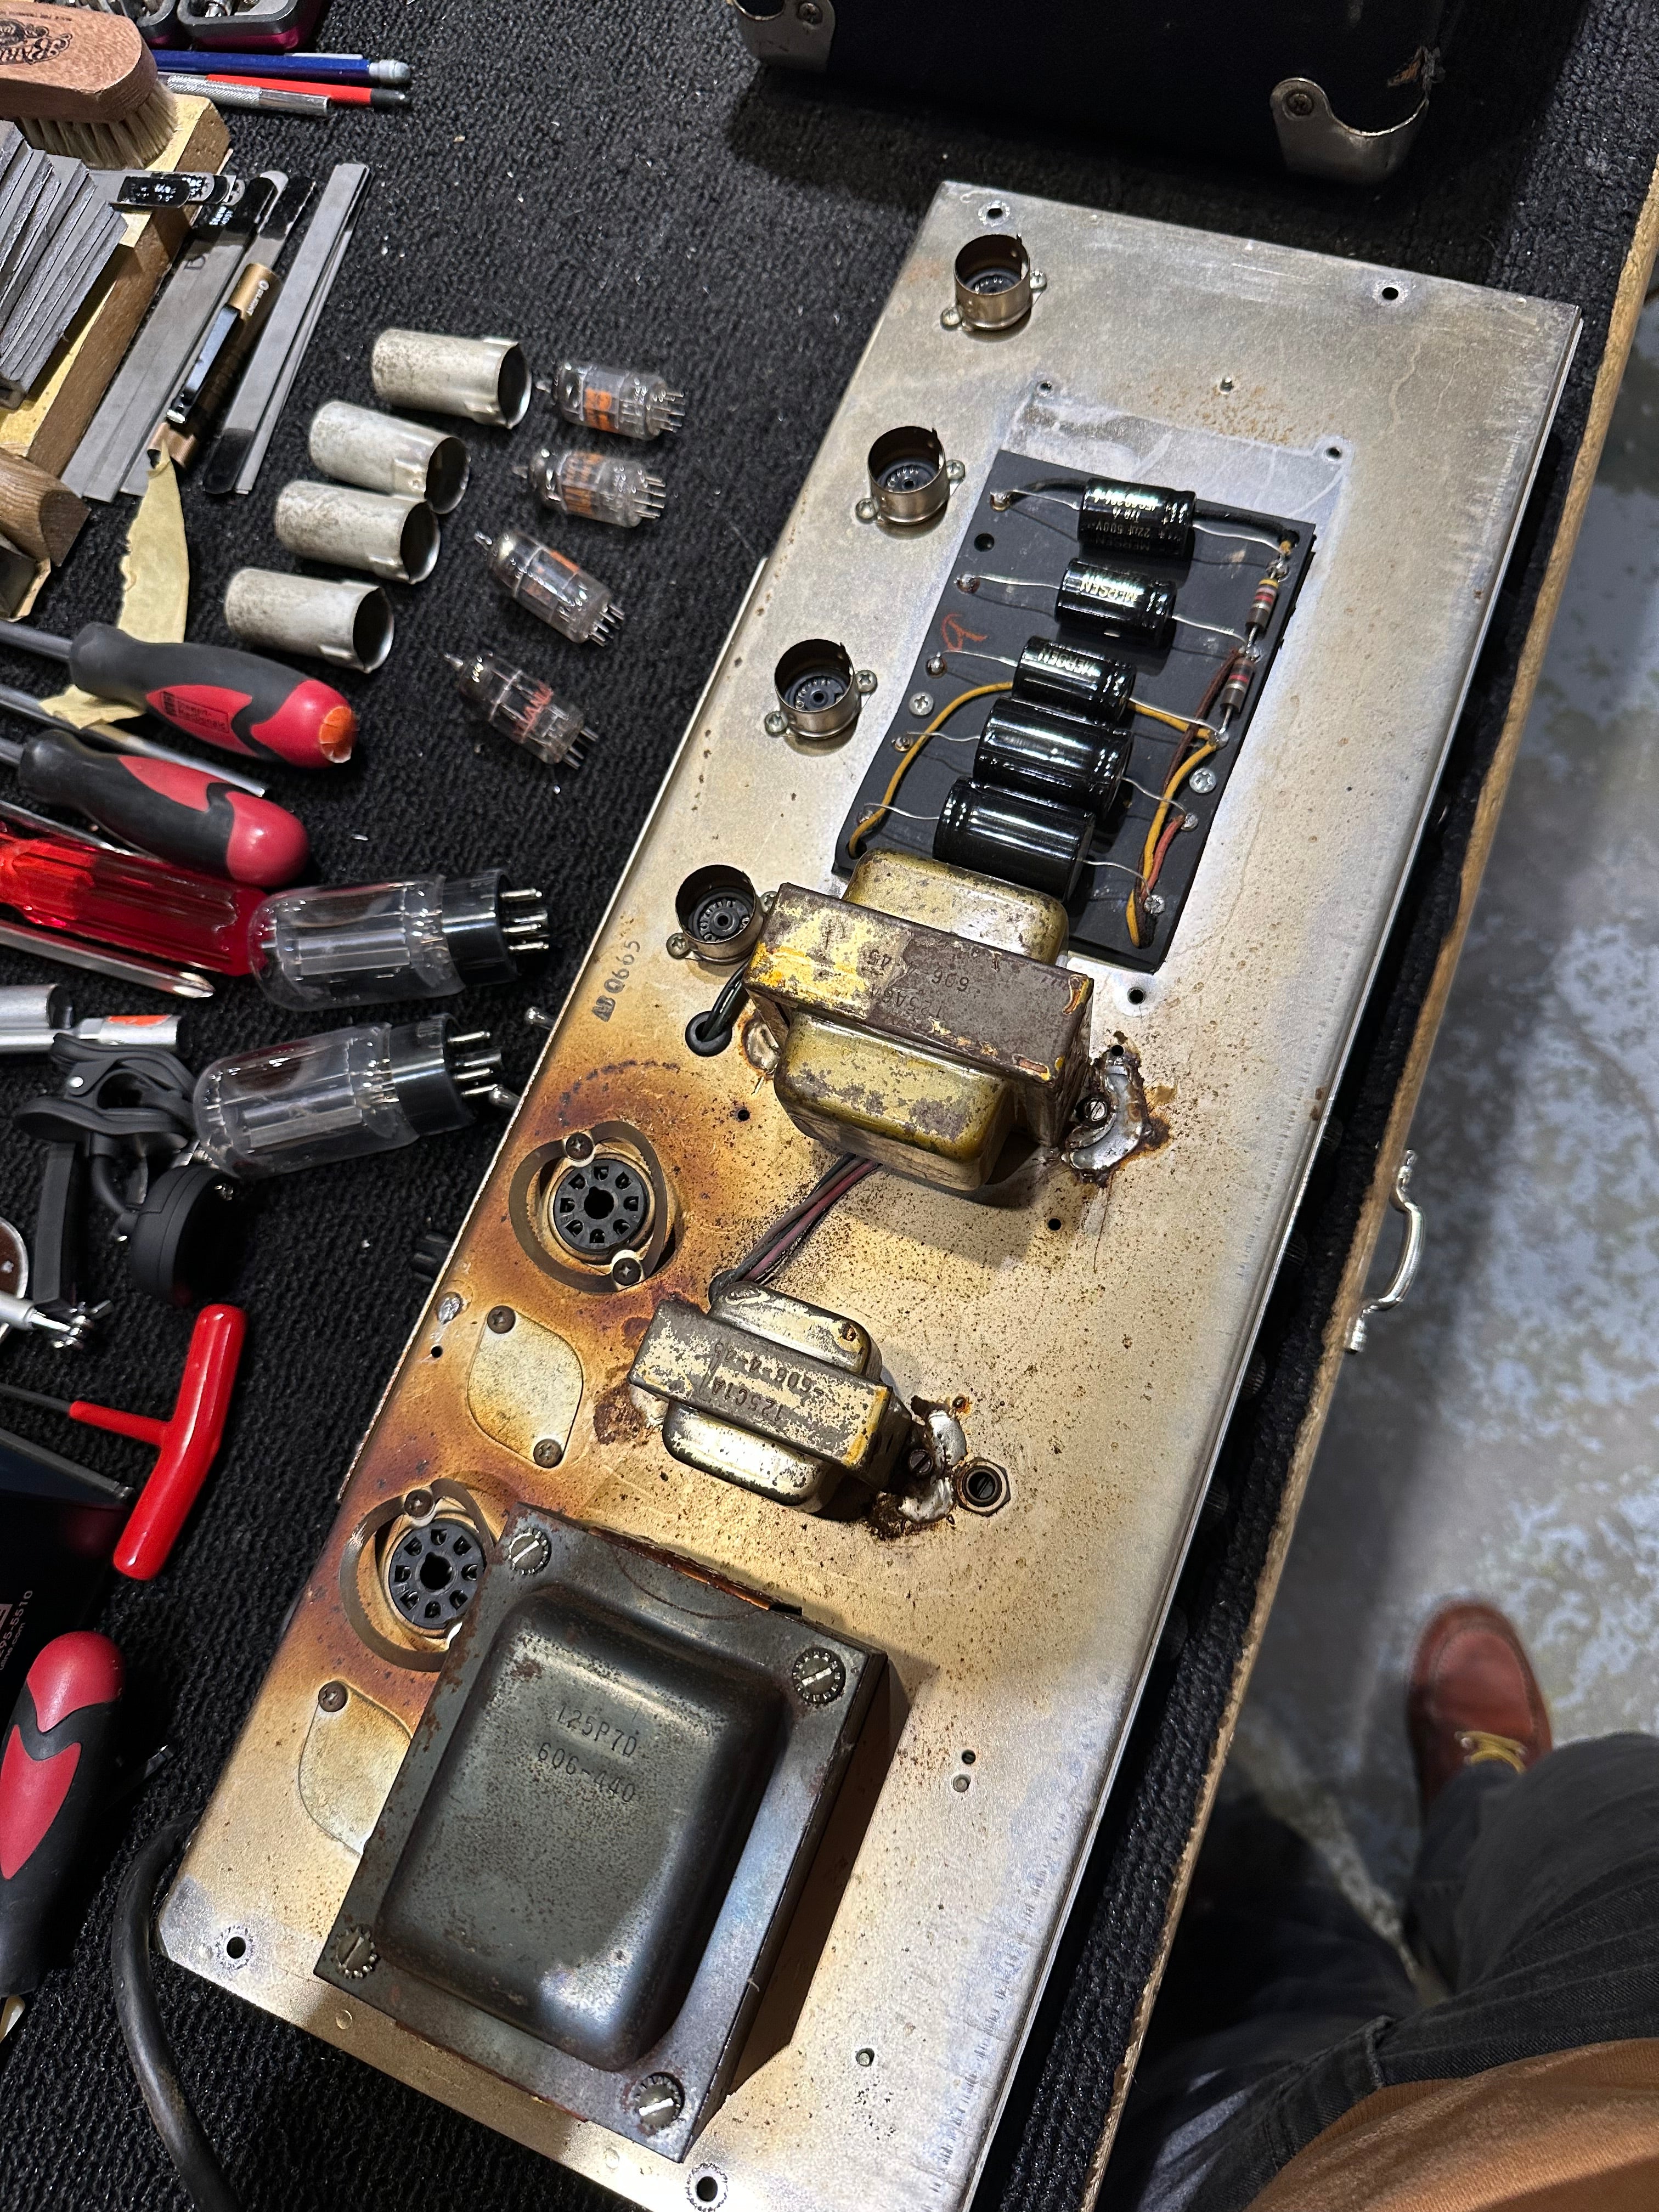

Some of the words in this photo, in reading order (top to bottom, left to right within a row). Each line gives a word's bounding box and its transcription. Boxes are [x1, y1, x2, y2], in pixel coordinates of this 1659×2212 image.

[713, 1376, 784, 1422] 125C1A
[557, 1703, 637, 1758] 125P7D
[538, 1742, 636, 1803] 606-440
